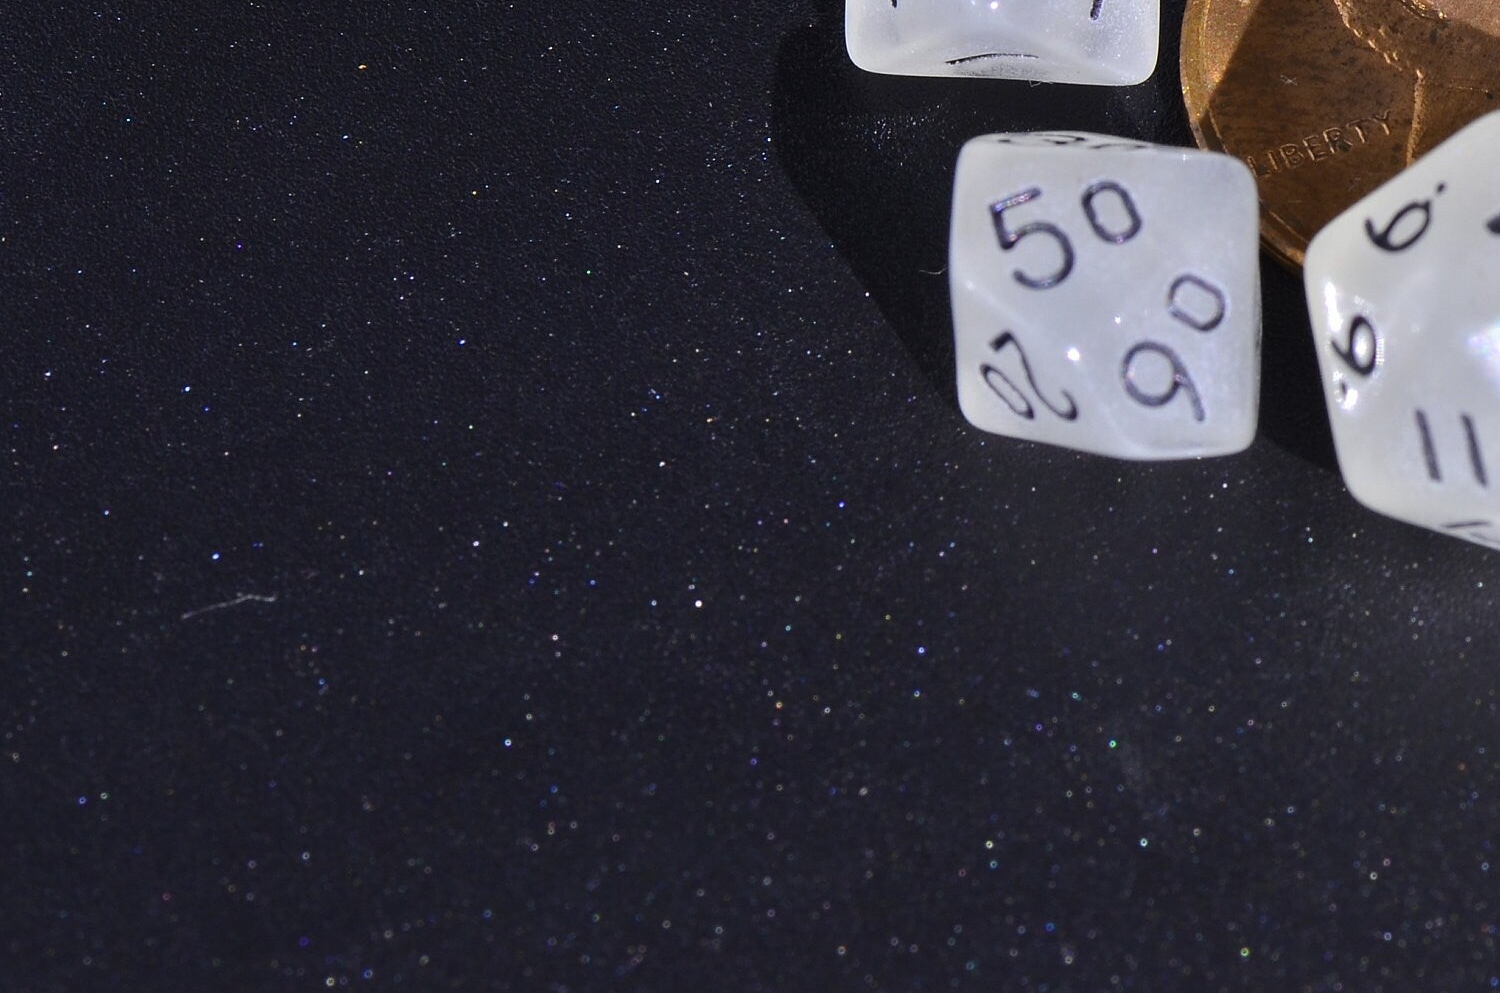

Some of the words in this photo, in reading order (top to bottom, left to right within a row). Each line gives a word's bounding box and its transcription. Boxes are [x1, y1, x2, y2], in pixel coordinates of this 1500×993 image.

[1247, 109, 1392, 178] LIBERTY
[989, 180, 1142, 291] 50
[1416, 409, 1490, 488] 11
